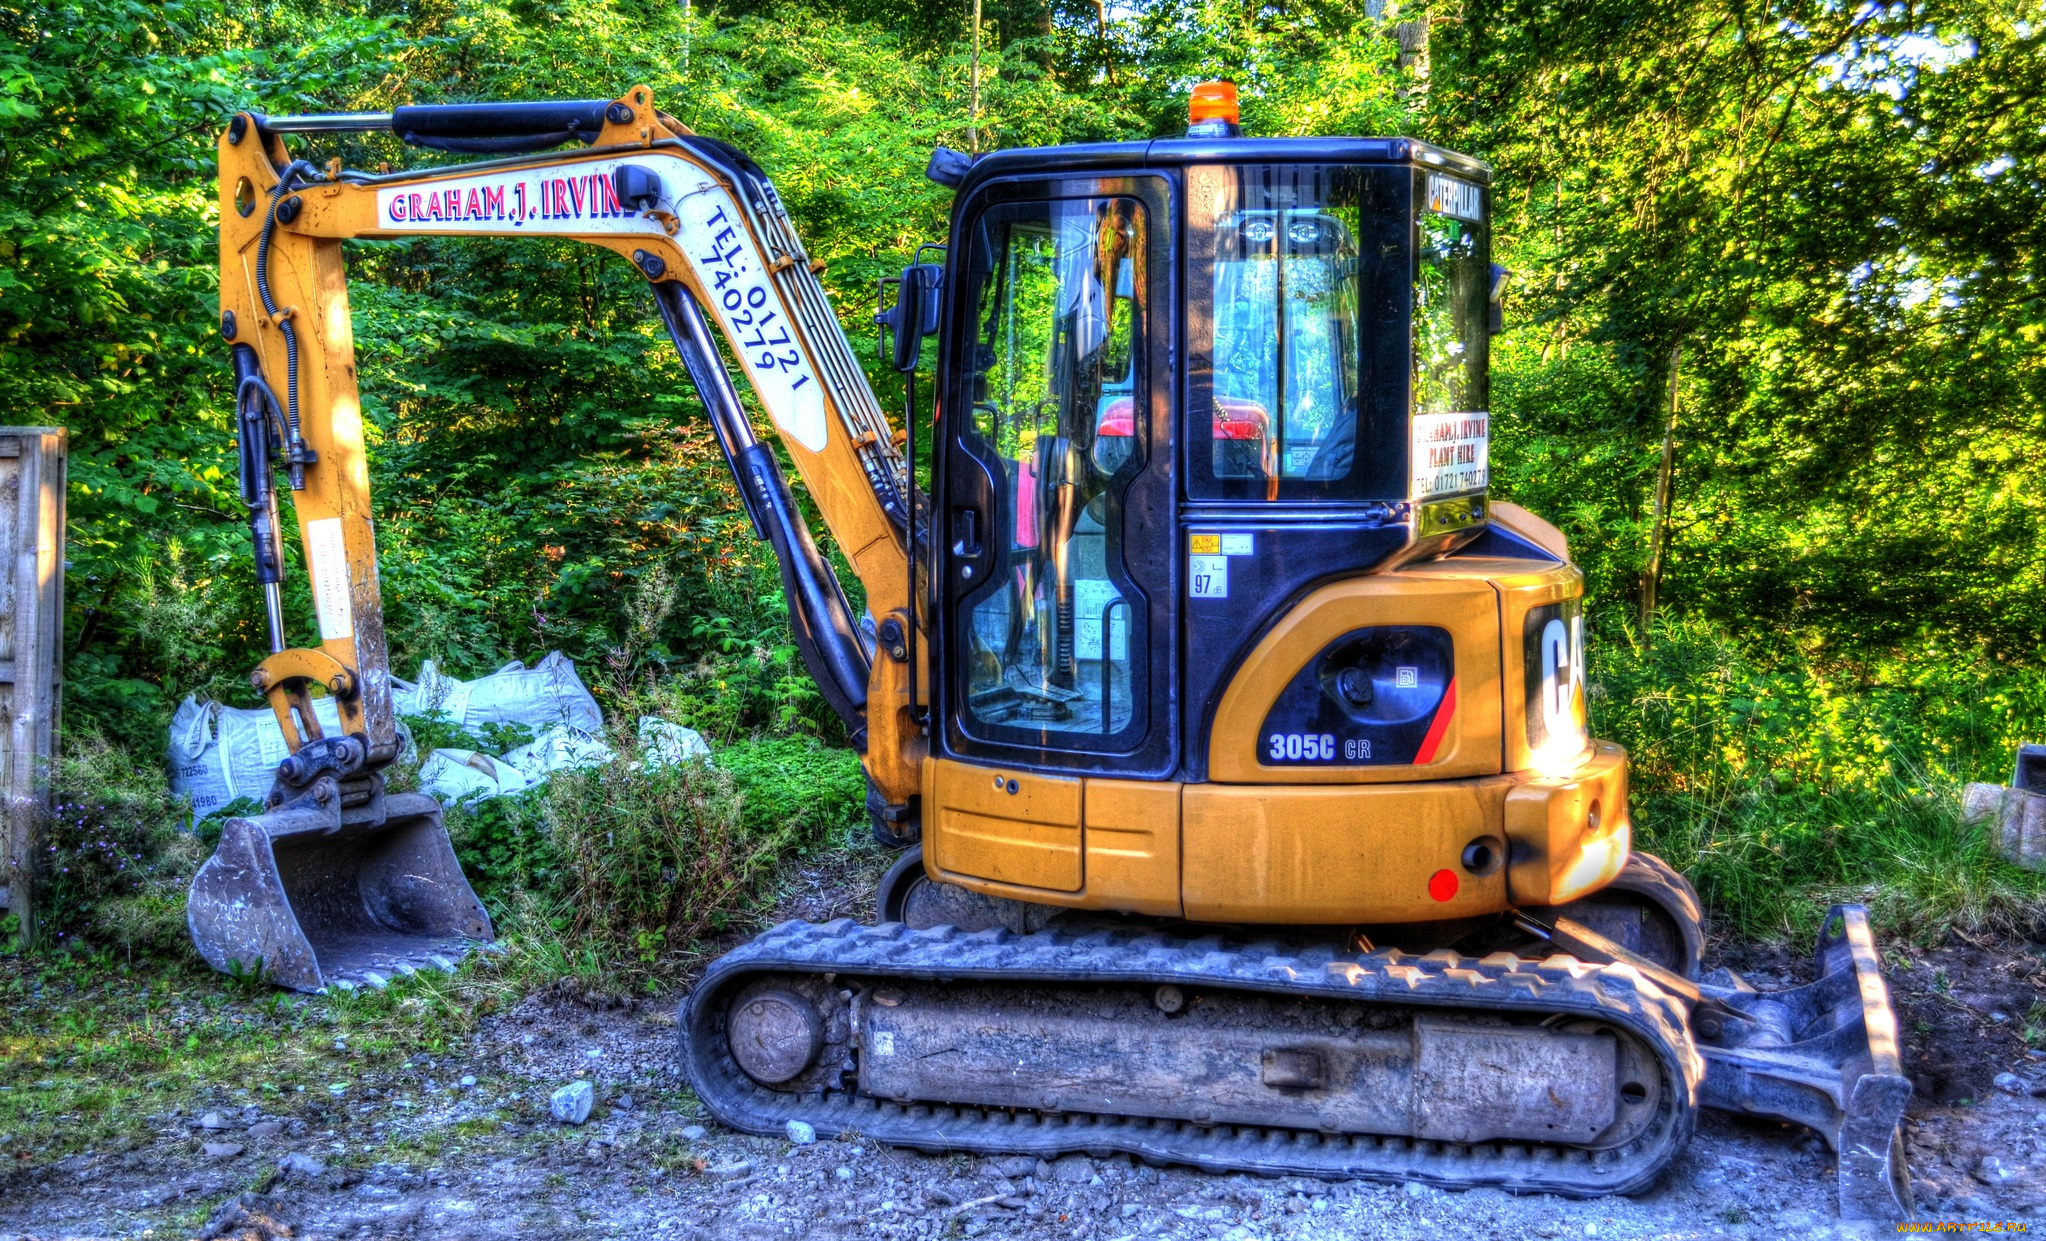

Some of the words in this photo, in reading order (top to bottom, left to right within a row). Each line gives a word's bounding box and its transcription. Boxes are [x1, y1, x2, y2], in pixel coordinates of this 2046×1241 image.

[1429, 175, 1479, 221] CATERPILLAR
[700, 244, 776, 370] 740279
[706, 205, 747, 278] TEL:
[746, 286, 810, 391] 01721
[1429, 446, 1455, 468] PLANT
[1457, 444, 1475, 465] HIRE
[1434, 473, 1457, 491] 01721
[1460, 469, 1486, 487] 740279
[1195, 574, 1211, 594] 97
[1269, 734, 1334, 759] 305C
[1344, 739, 1371, 759] CR
